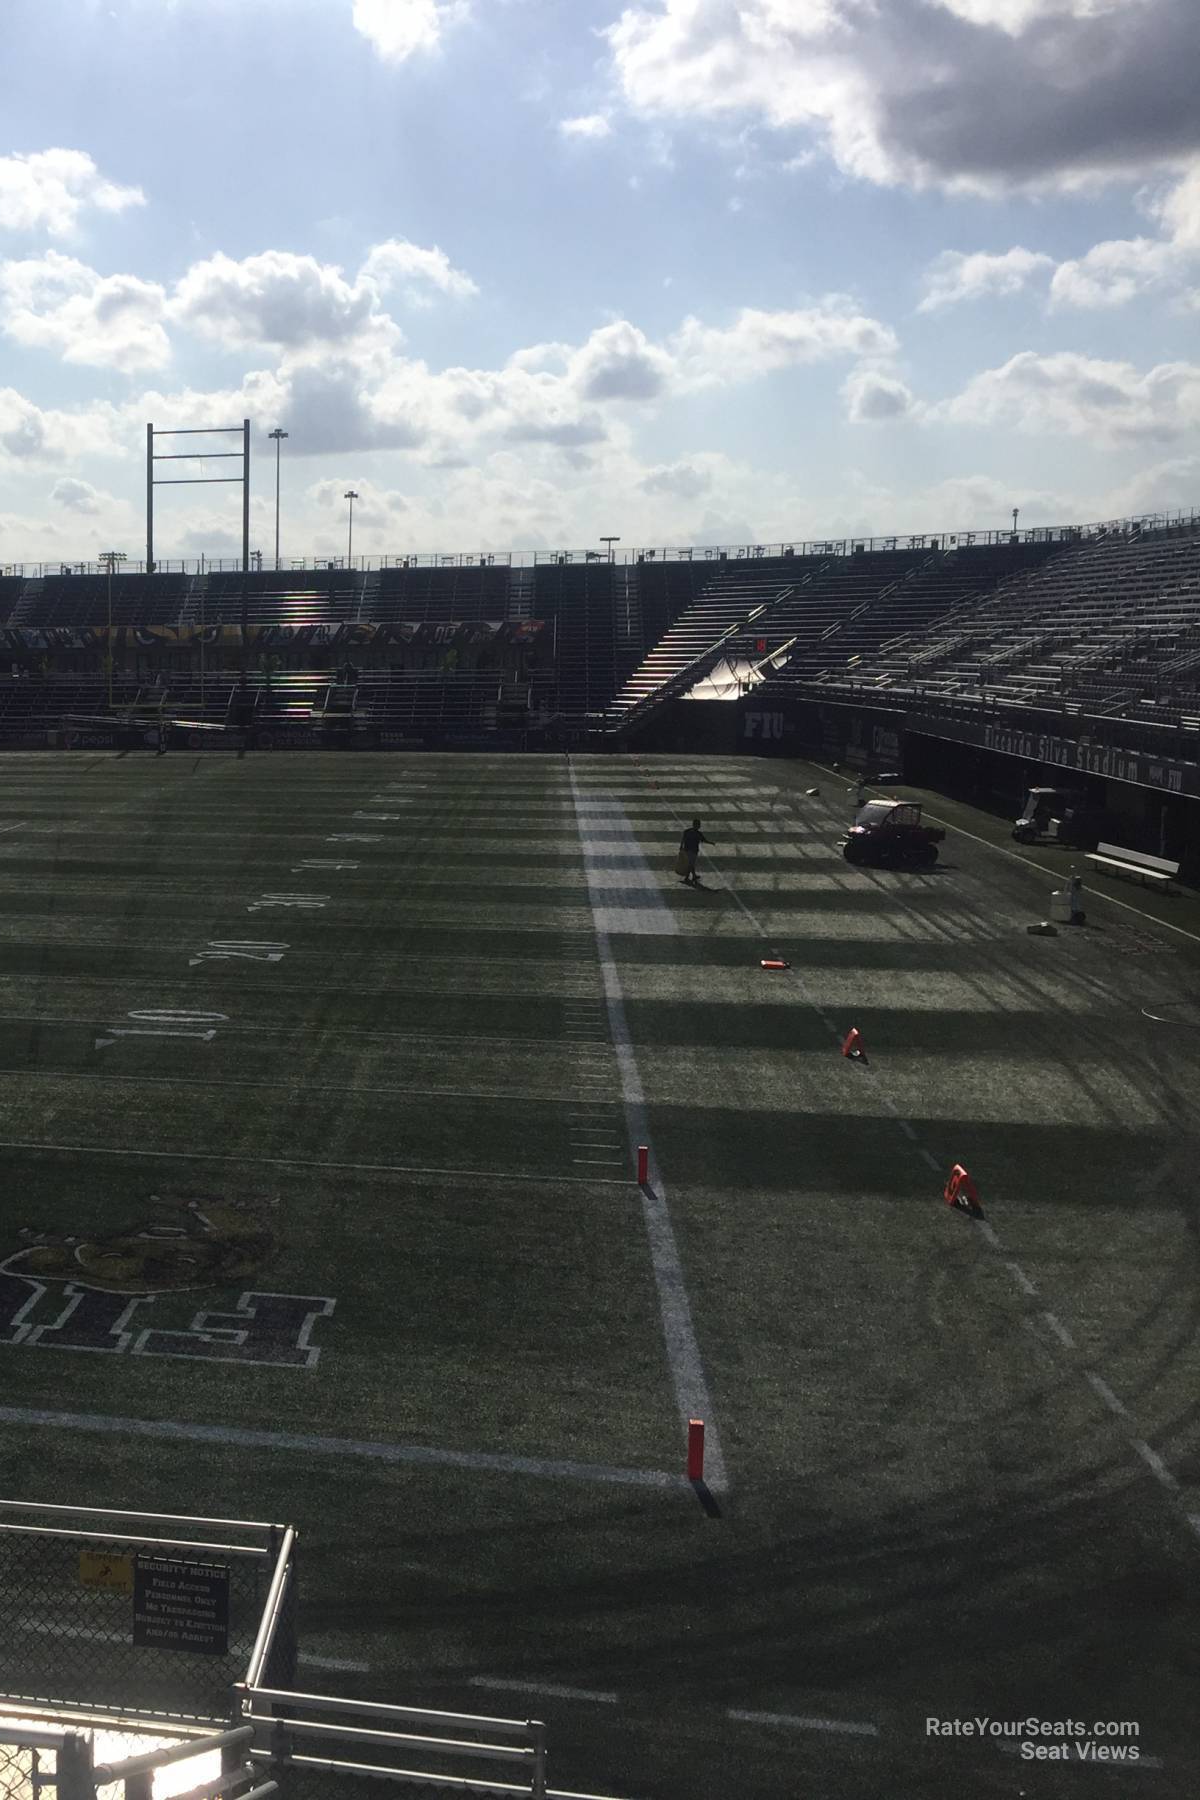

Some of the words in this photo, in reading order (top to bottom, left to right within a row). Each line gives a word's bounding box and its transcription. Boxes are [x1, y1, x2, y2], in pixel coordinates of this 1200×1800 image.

[743, 712, 784, 740] FIU
[984, 727, 1032, 757] Riccardo
[1039, 736, 1069, 766] Silva
[1076, 745, 1138, 782] Stadium
[197, 940, 292, 962] 20
[106, 1009, 231, 1041] 10
[137, 1561, 187, 1575] SECURITY
[190, 1567, 226, 1579] NOTICE
